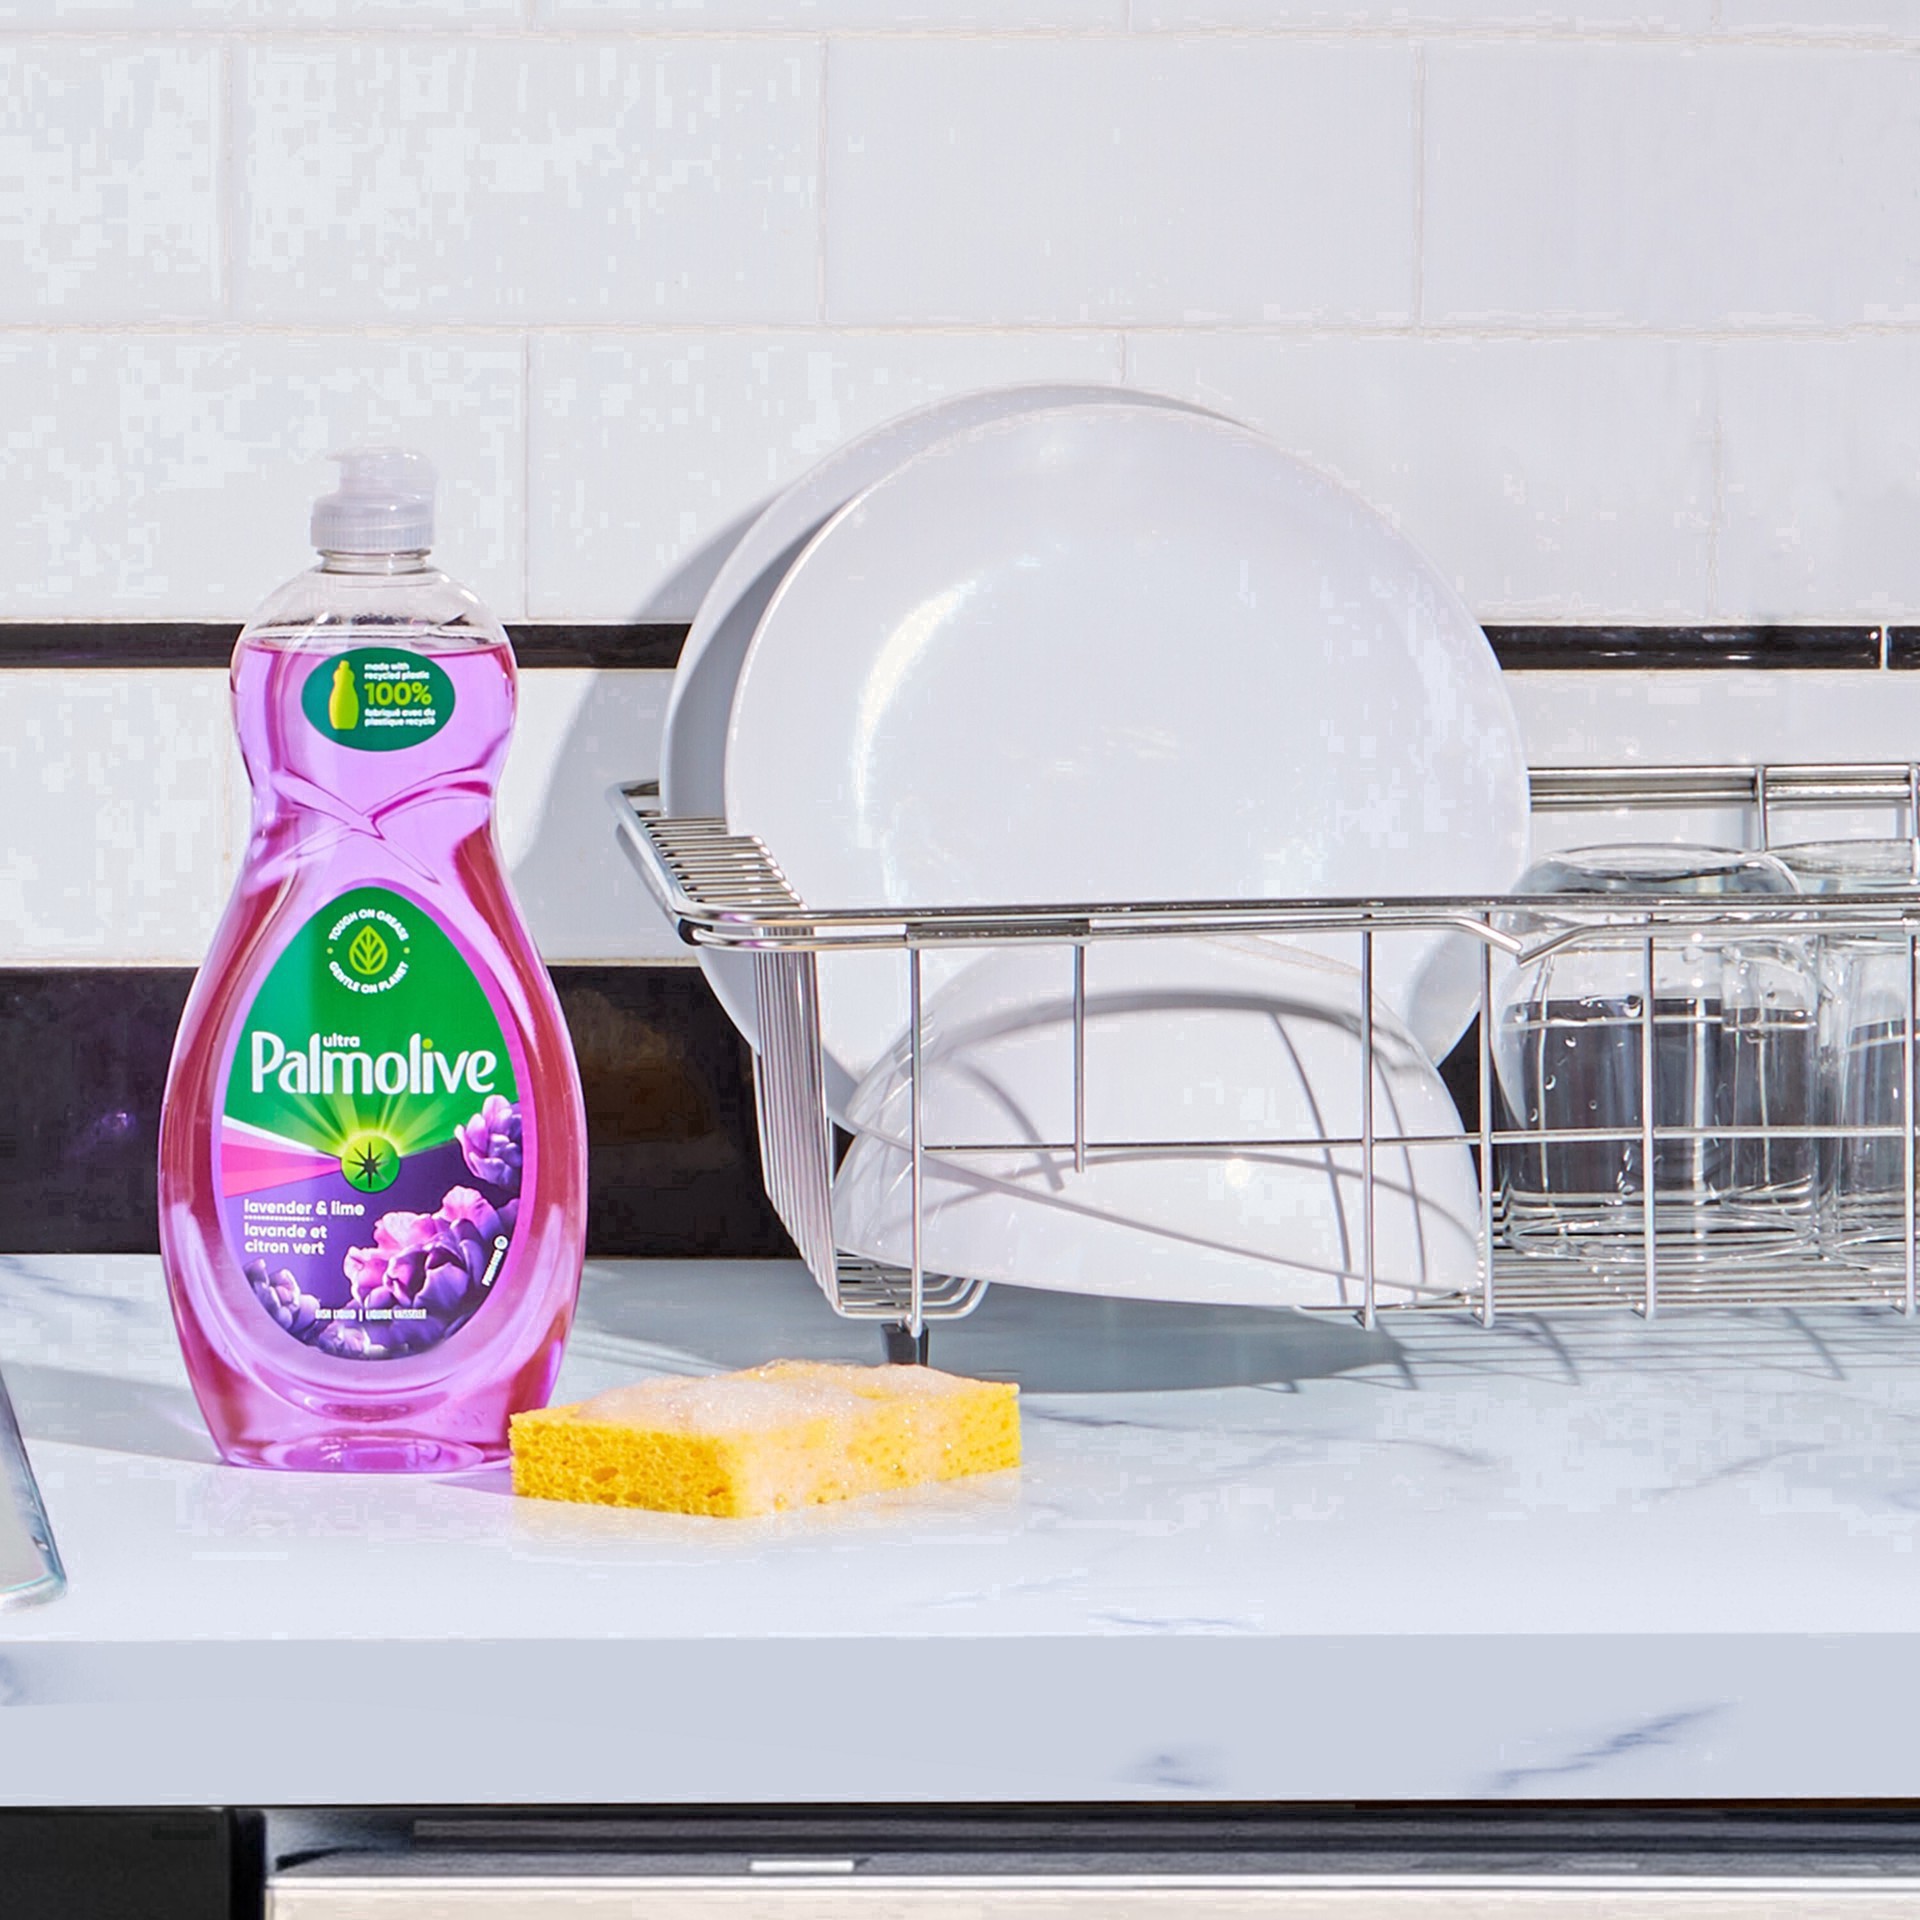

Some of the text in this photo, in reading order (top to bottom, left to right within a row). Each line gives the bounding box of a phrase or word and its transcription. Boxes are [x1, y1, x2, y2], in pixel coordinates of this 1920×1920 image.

[364, 671, 400, 681] recycled
[364, 681, 432, 706] 100%
[328, 908, 409, 941] TOUGH ON GREASE
[329, 961, 409, 994] GENTLE ON PLANET
[322, 1033, 361, 1047] ultra
[251, 1030, 497, 1095] Palmolive
[244, 1198, 365, 1217] lavender & lime
[244, 1222, 328, 1239] lavande et
[244, 1239, 325, 1255] citron vert
